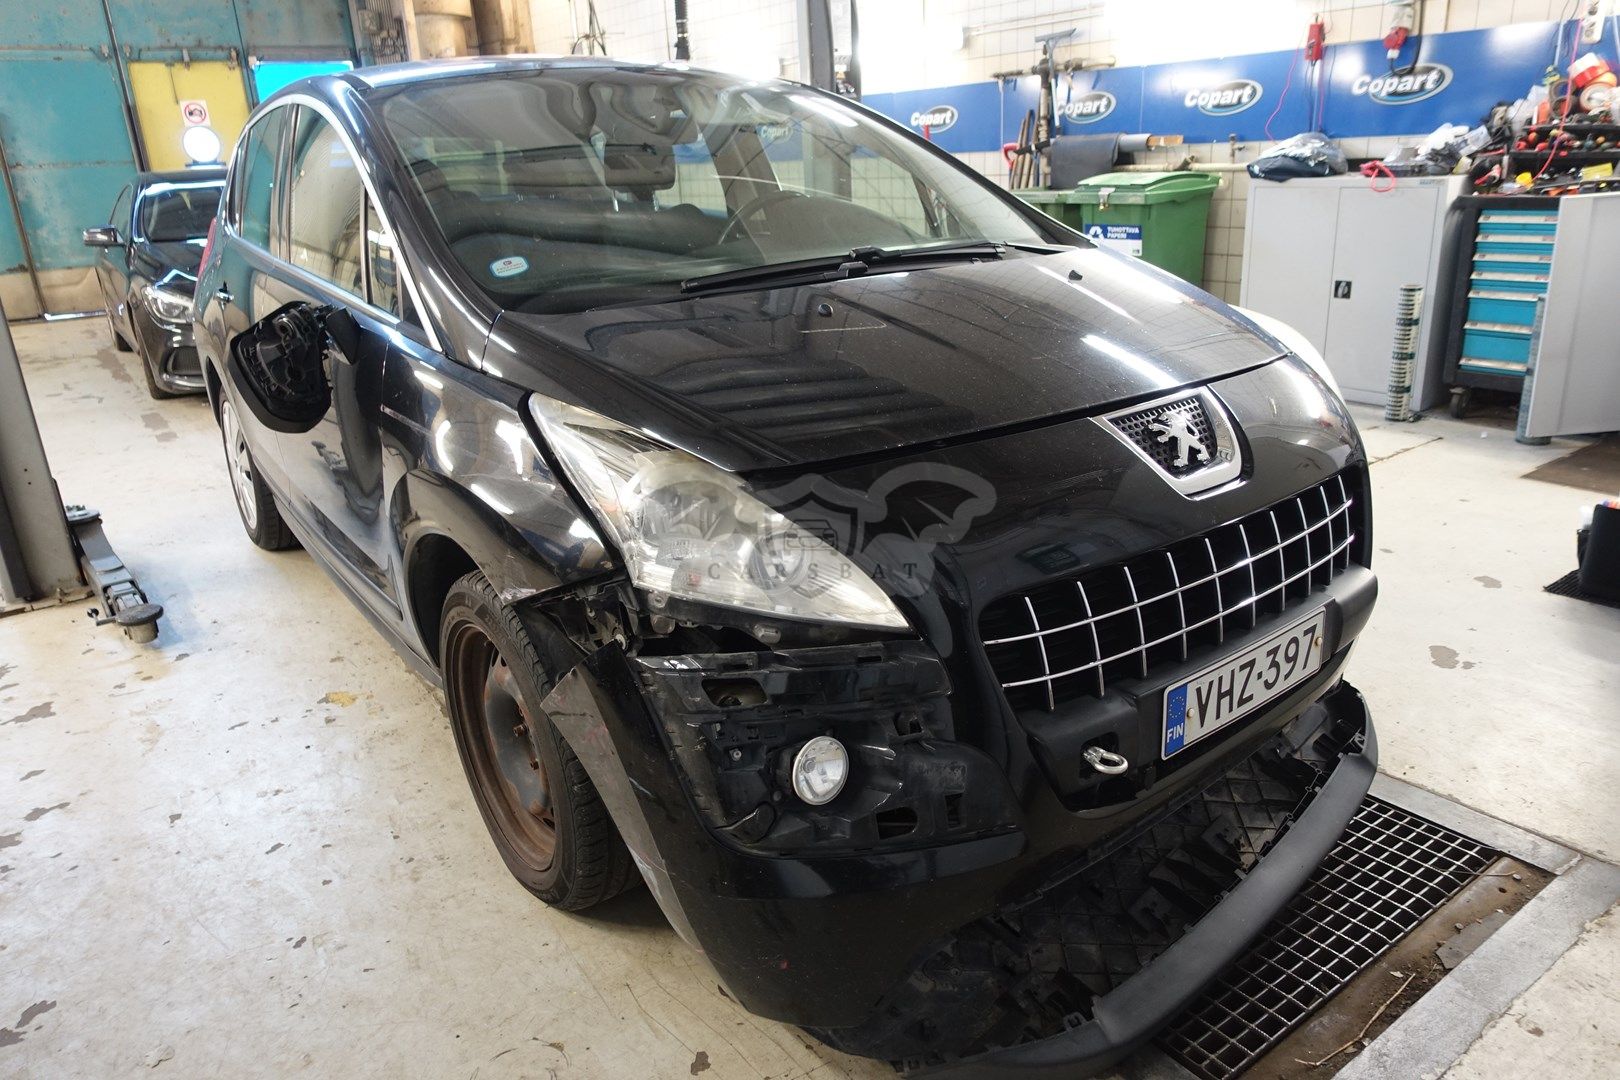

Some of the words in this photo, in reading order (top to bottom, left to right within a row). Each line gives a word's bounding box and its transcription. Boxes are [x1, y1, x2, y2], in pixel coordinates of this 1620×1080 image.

[1352, 69, 1440, 97] Copart
[1184, 85, 1252, 109] Copart
[911, 110, 952, 127] Copart
[1195, 623, 1318, 728] VHZ-397
[1166, 722, 1184, 743] FIN
